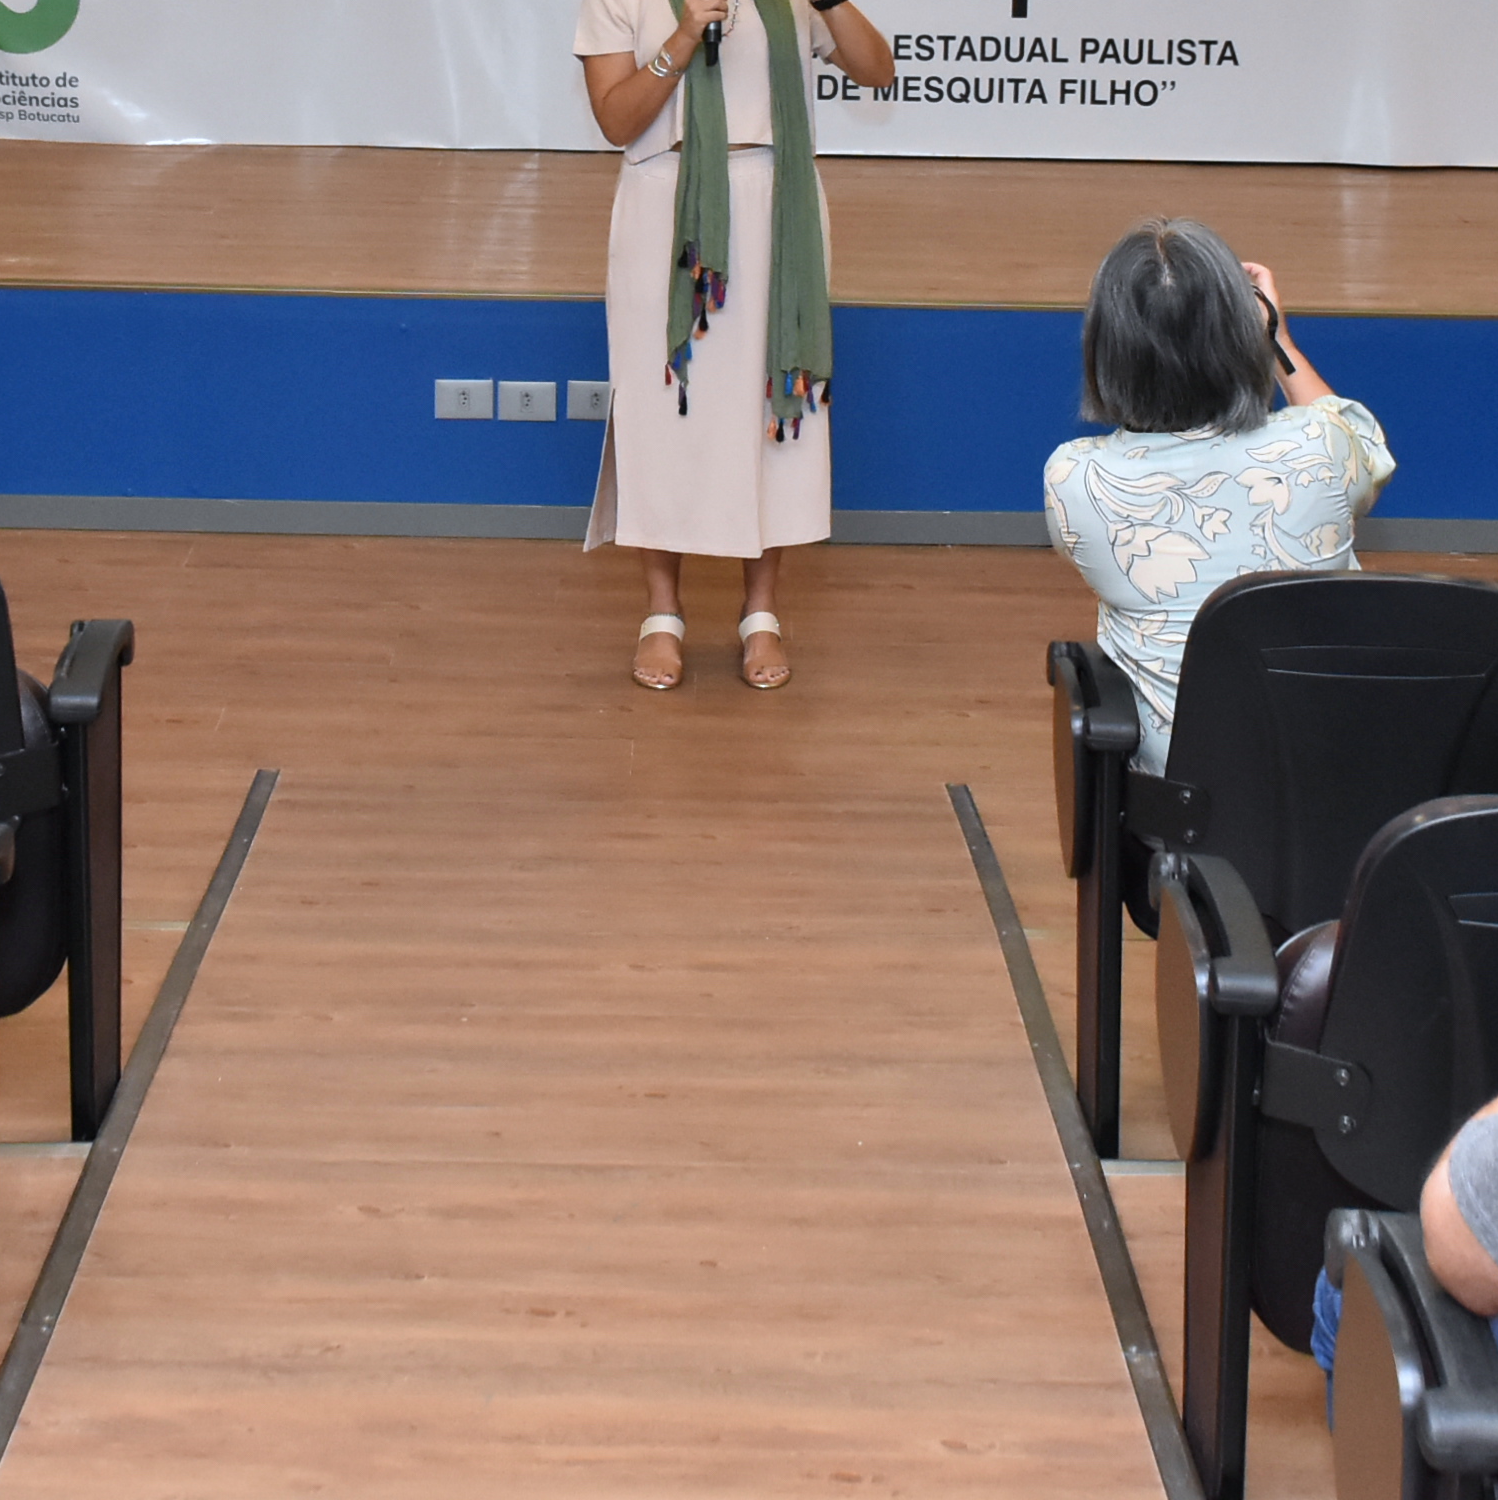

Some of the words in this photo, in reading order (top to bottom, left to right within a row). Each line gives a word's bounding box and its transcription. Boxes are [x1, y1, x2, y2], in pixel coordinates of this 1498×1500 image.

[893, 34, 1069, 63] ESTADUAL
[1080, 37, 1240, 66] PAULISTA
[54, 71, 80, 88] de
[18, 109, 80, 124] Botucatu
